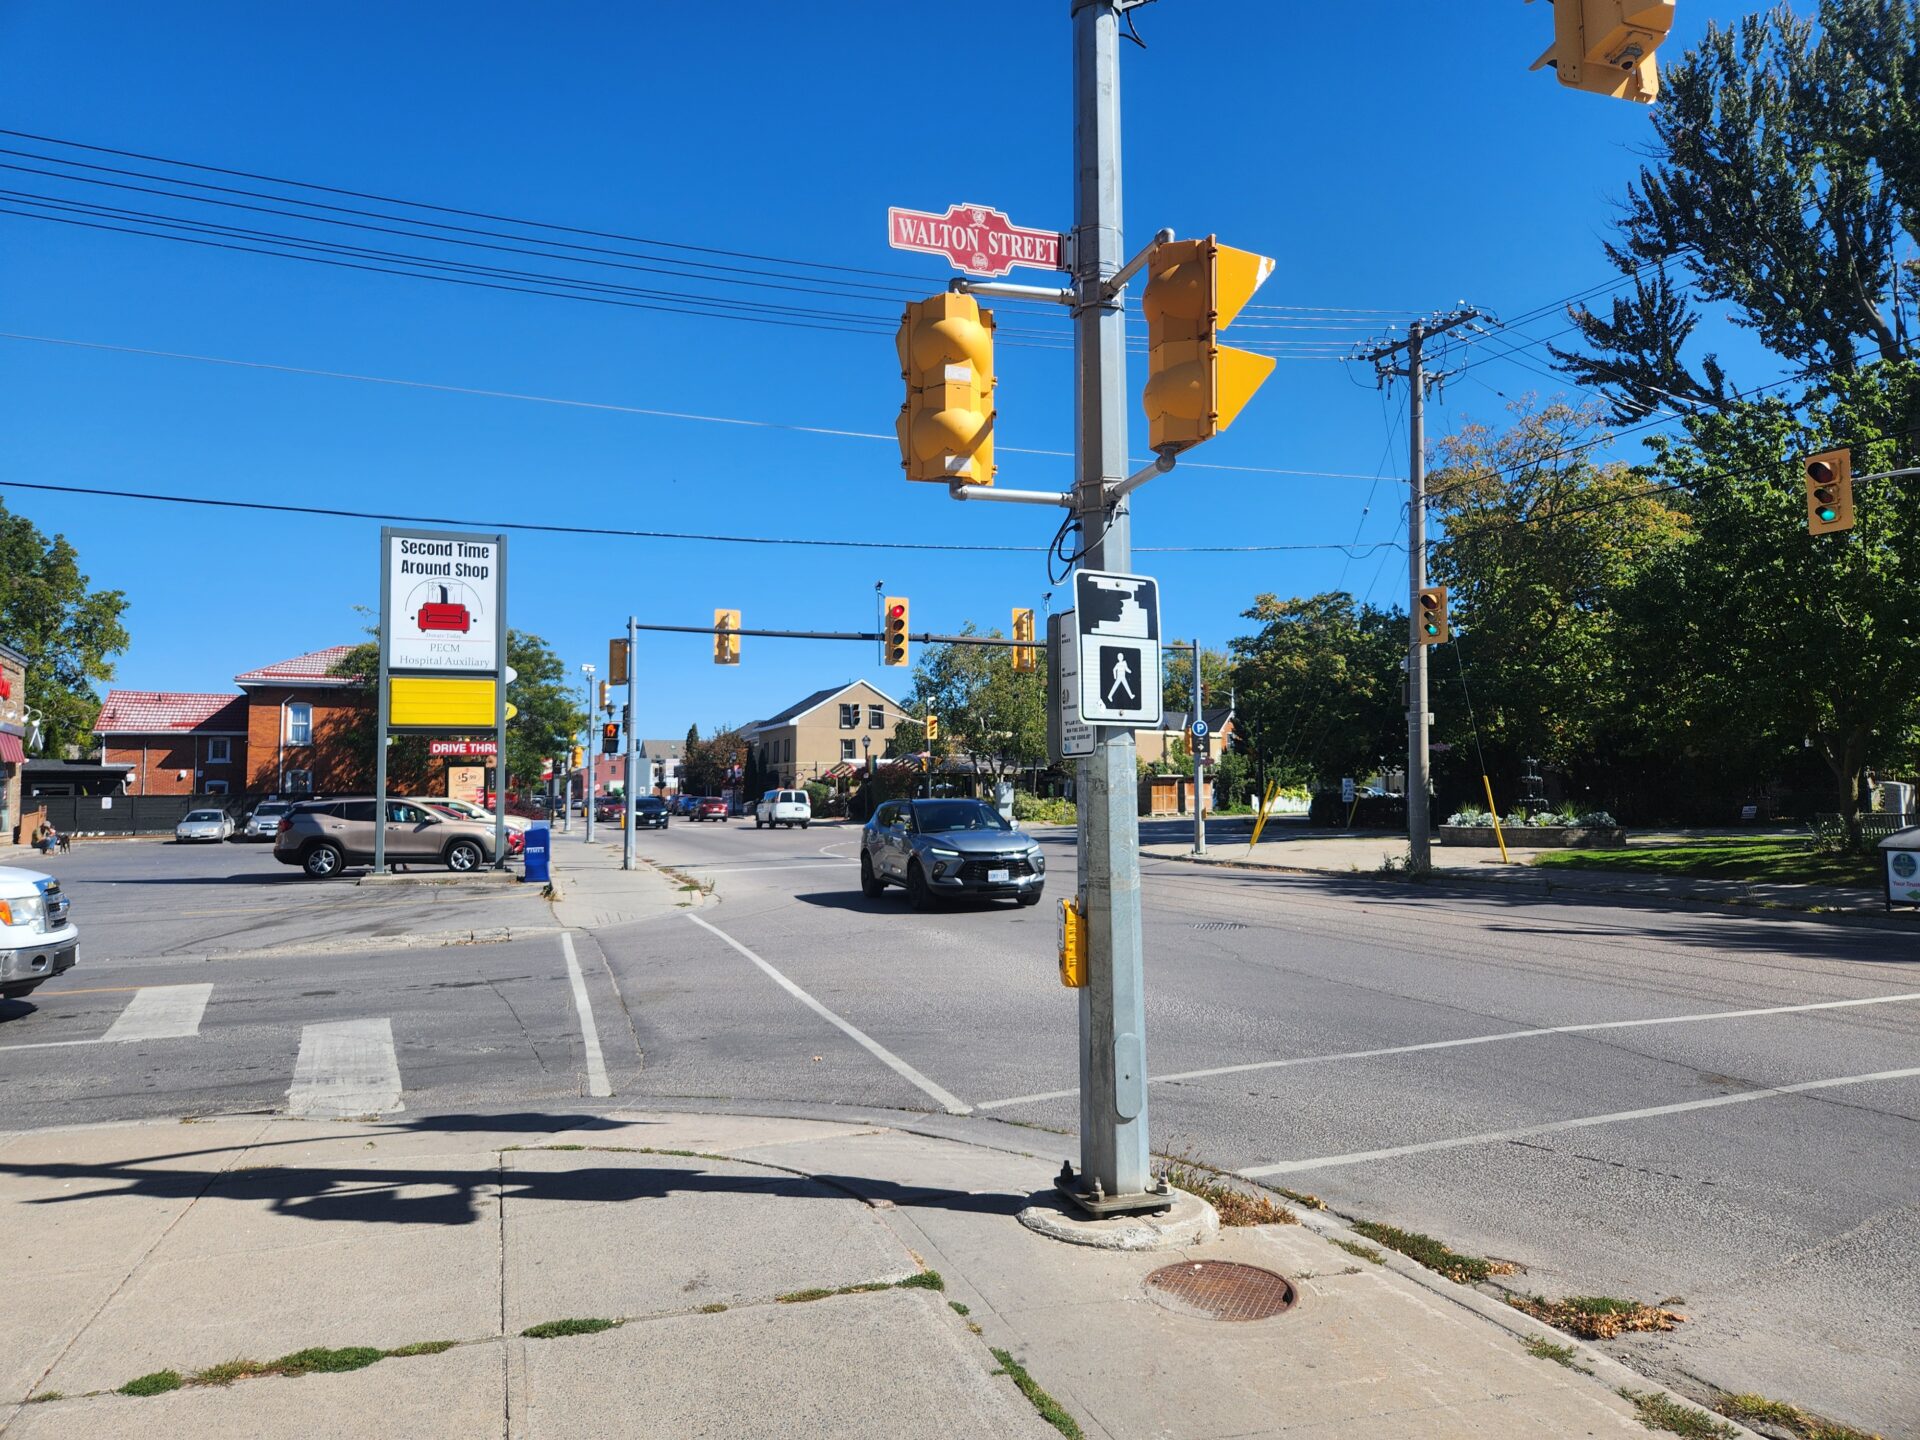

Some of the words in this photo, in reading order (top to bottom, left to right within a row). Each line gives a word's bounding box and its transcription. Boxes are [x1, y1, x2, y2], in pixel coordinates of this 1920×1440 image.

[897, 217, 979, 252] WALTON
[988, 231, 1058, 263] STREET
[401, 539, 453, 556] Second
[457, 543, 490, 559] Time
[401, 559, 451, 576] Around
[455, 562, 489, 580] Shop
[430, 643, 460, 653] PECM
[400, 655, 442, 667] Hospital
[444, 657, 490, 669] Auxiliary
[1197, 723, 1204, 733] P
[432, 743, 467, 753] DRIVE
